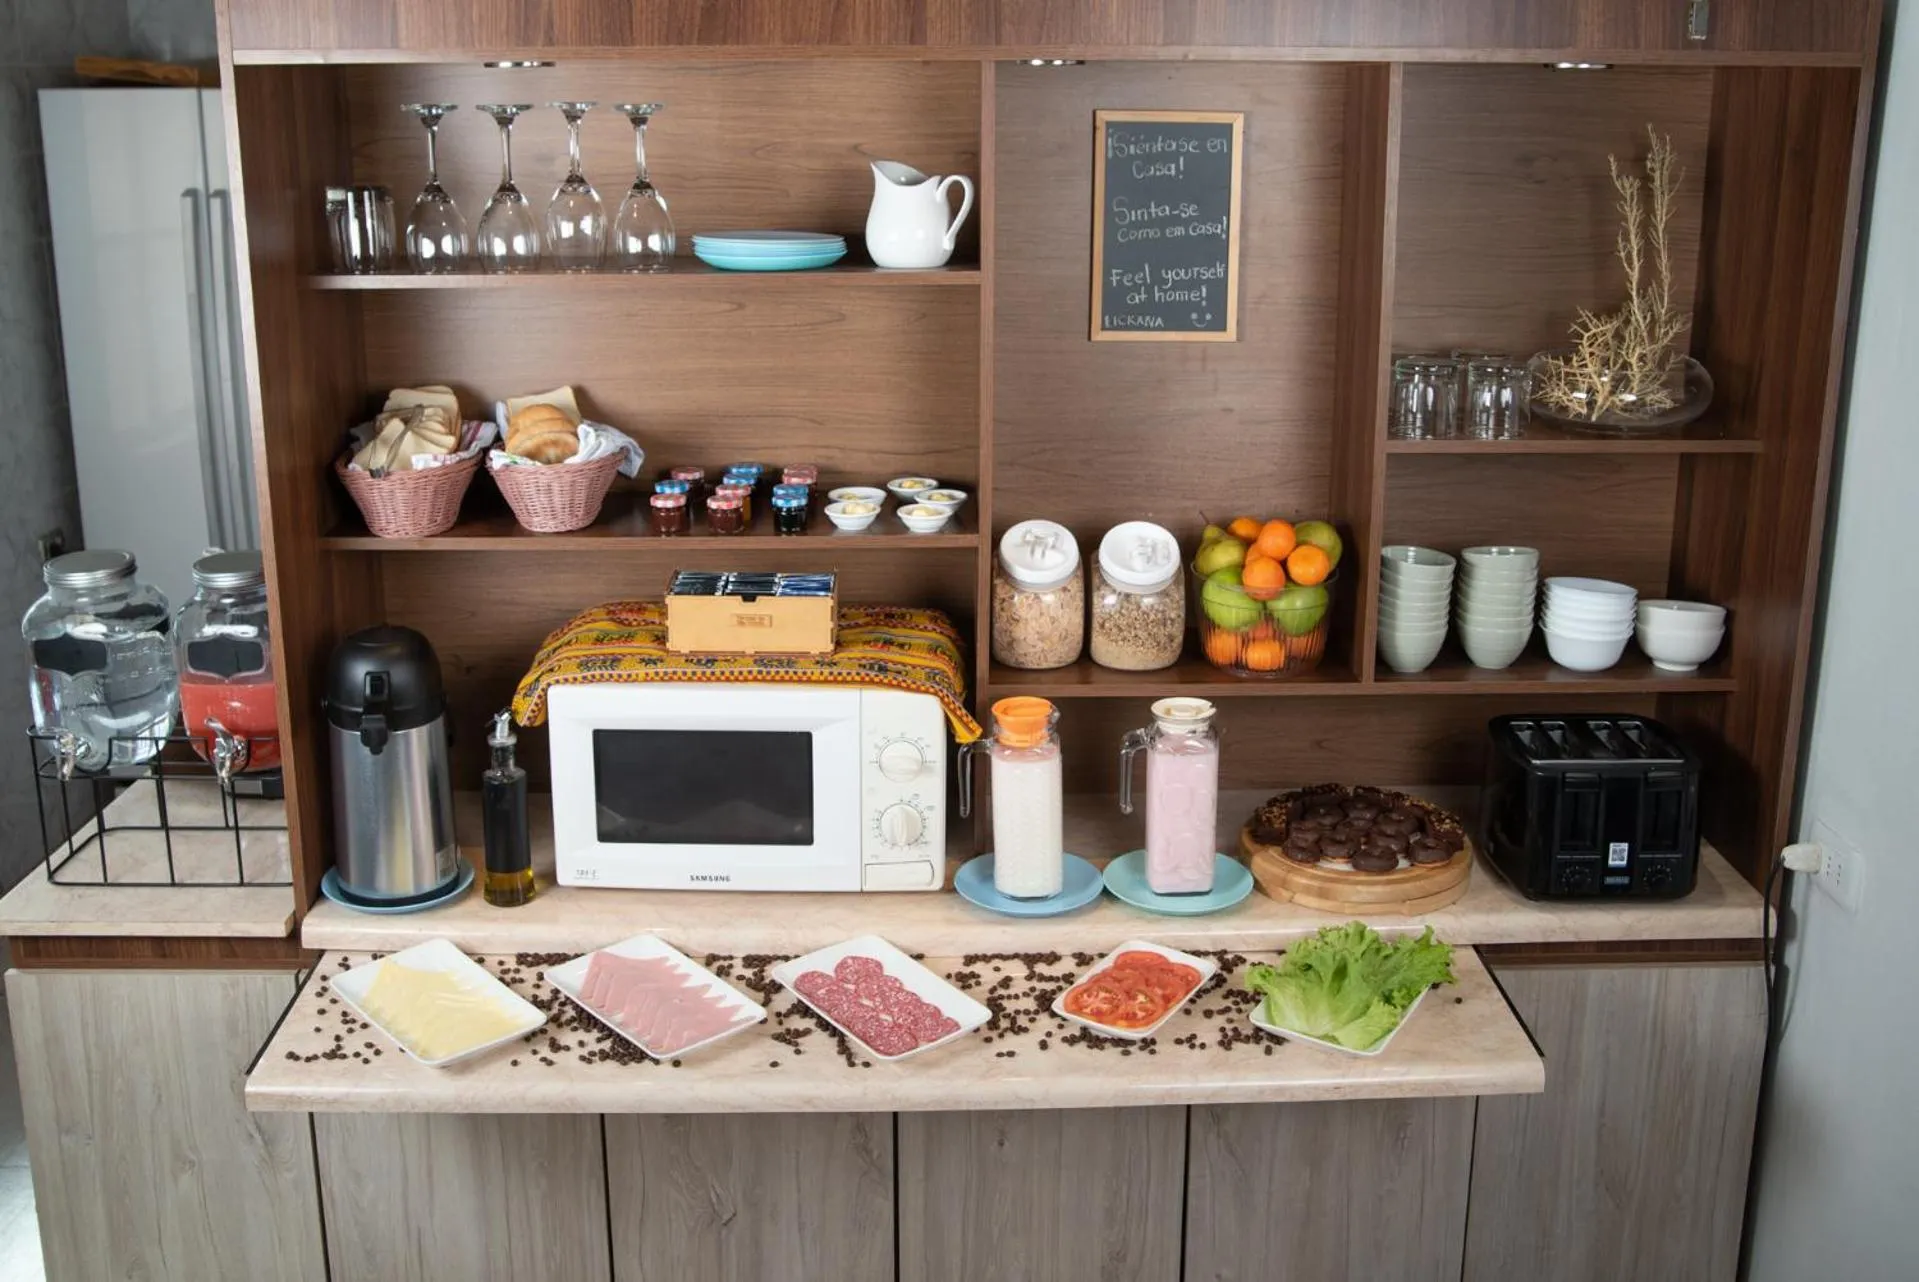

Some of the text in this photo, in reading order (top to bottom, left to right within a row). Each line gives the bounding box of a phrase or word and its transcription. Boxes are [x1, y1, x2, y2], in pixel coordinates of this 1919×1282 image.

[1207, 137, 1228, 154] en
[1112, 195, 1200, 226] Sinta-se
[1165, 225, 1186, 238] em
[1110, 262, 1151, 287] Feel
[1126, 284, 1208, 307] at home!
